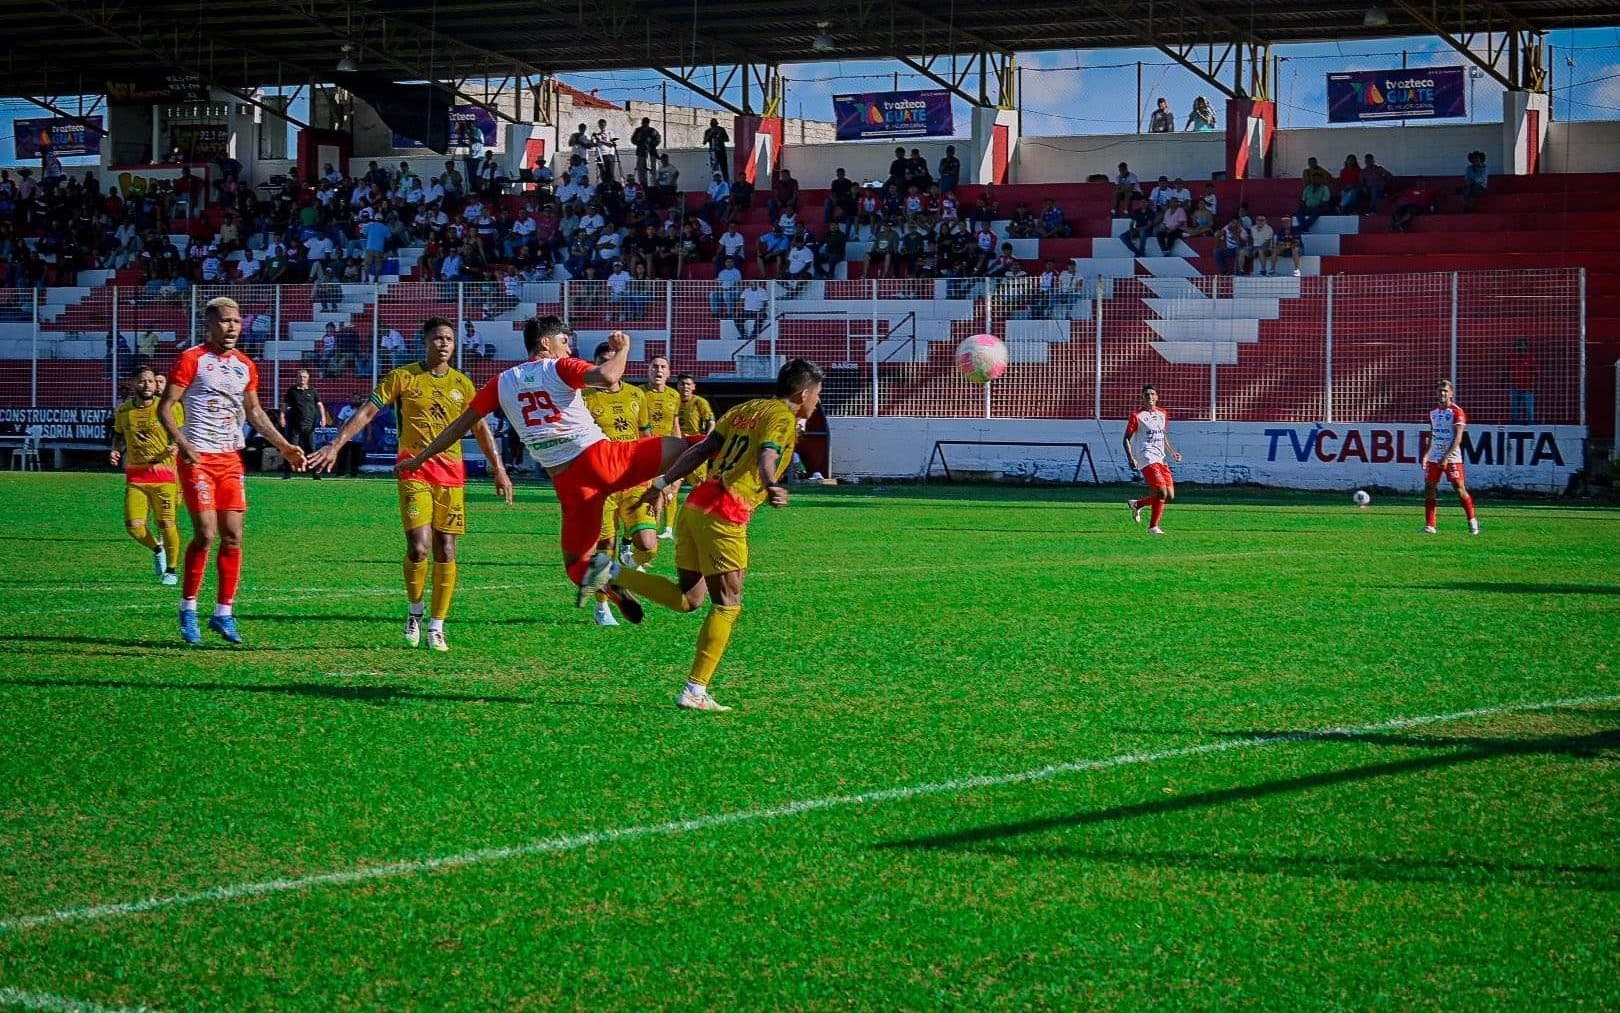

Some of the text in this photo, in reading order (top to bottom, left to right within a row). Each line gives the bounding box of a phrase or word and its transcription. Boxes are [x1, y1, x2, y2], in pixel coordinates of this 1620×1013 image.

[1397, 79, 1434, 88] azteca
[895, 99, 926, 109] azteca
[0, 408, 79, 423] CONSTRUCCION
[518, 390, 562, 427] 29
[720, 433, 751, 475] 12
